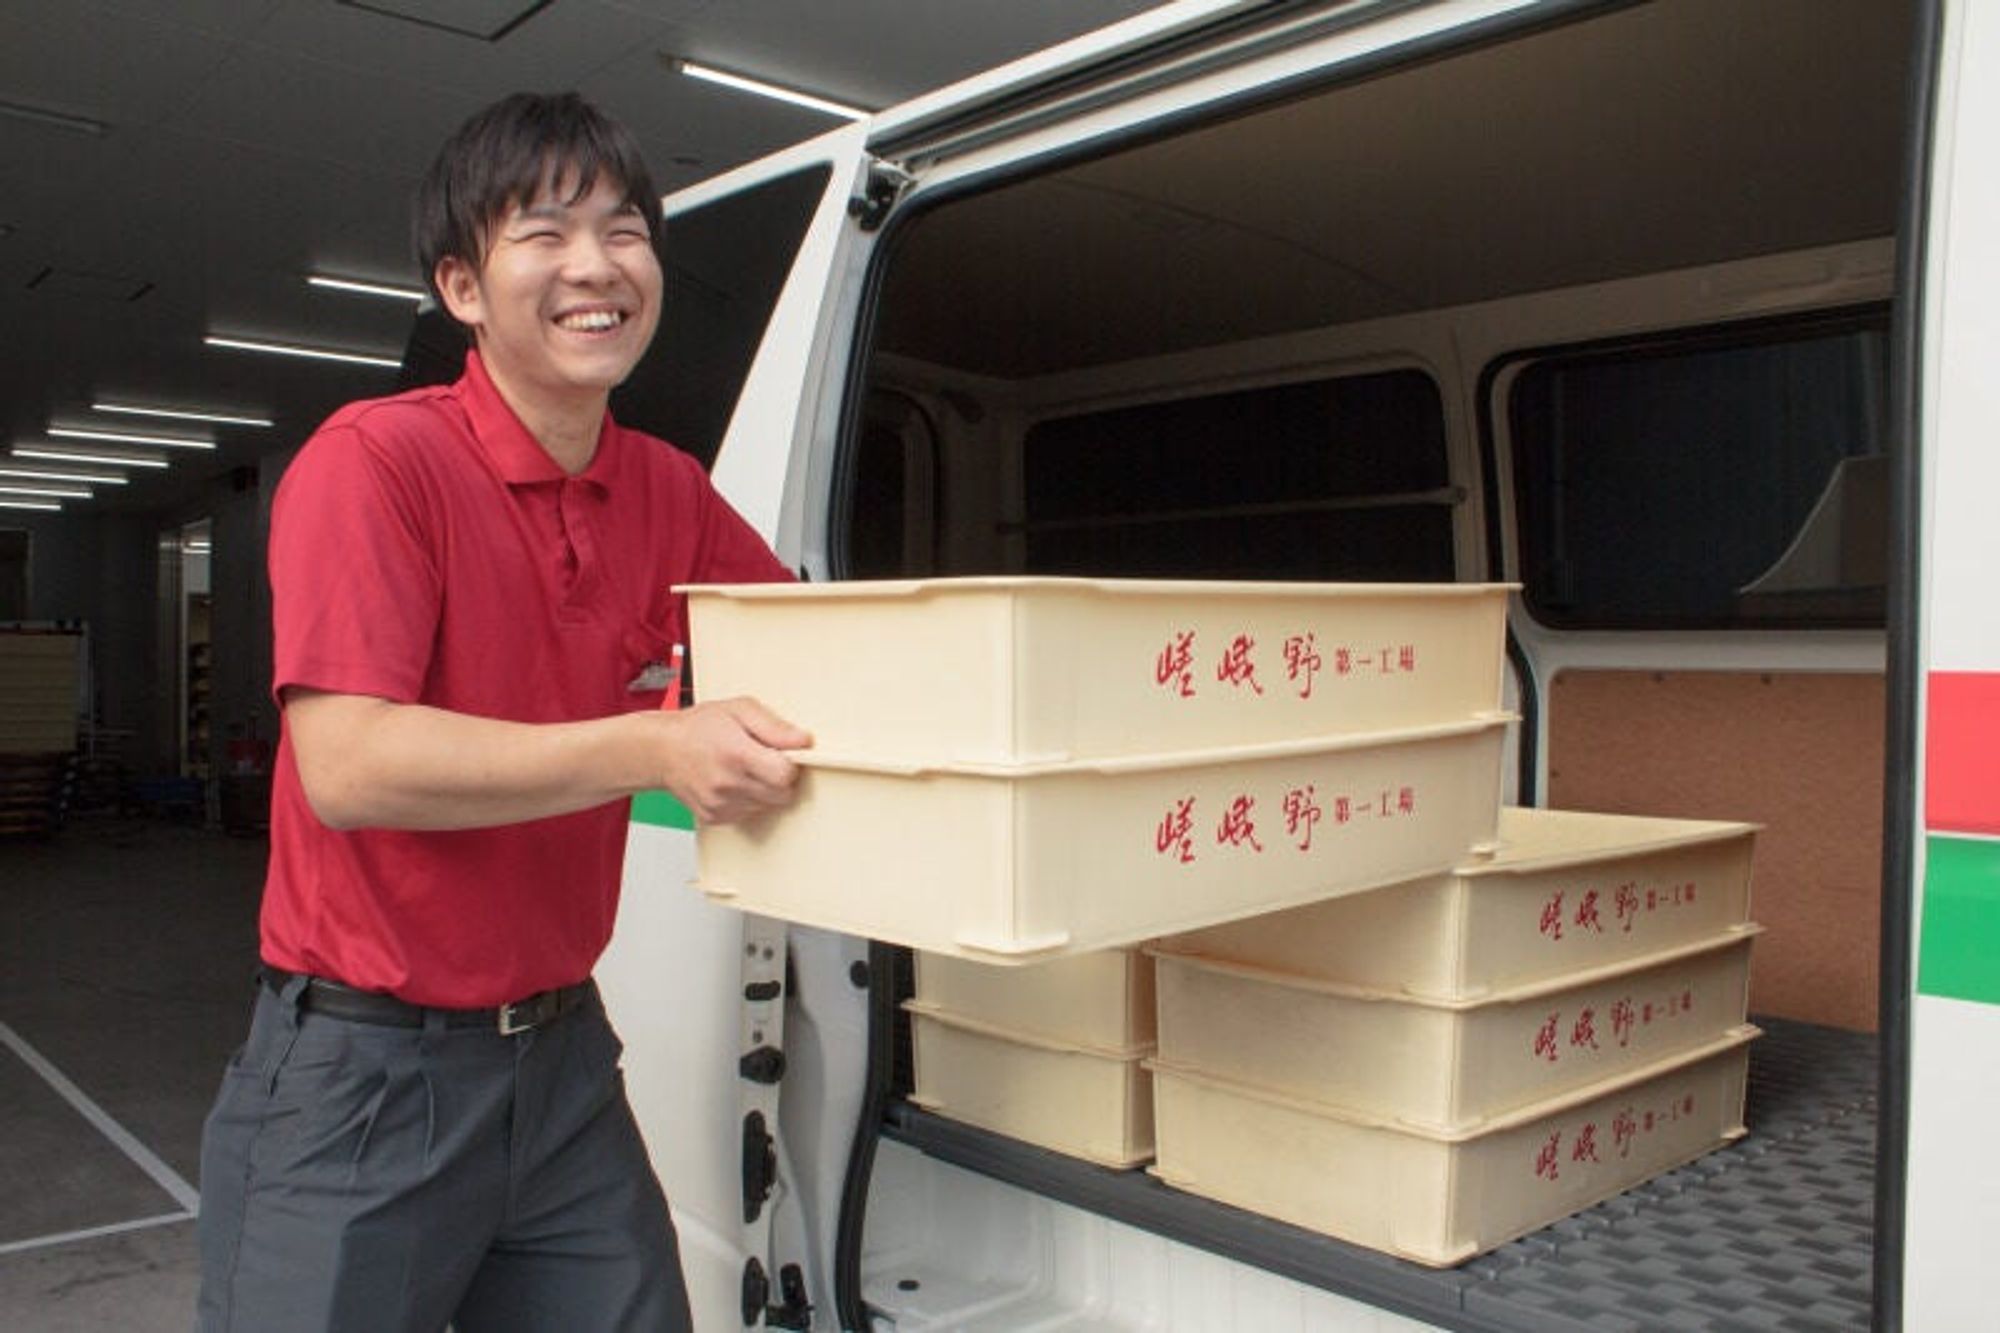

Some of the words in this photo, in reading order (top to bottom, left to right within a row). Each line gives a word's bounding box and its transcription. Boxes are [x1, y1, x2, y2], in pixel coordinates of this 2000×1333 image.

[1156, 631, 1322, 700] 嵯峨野
[1156, 785, 1322, 864] 嵯峨野
